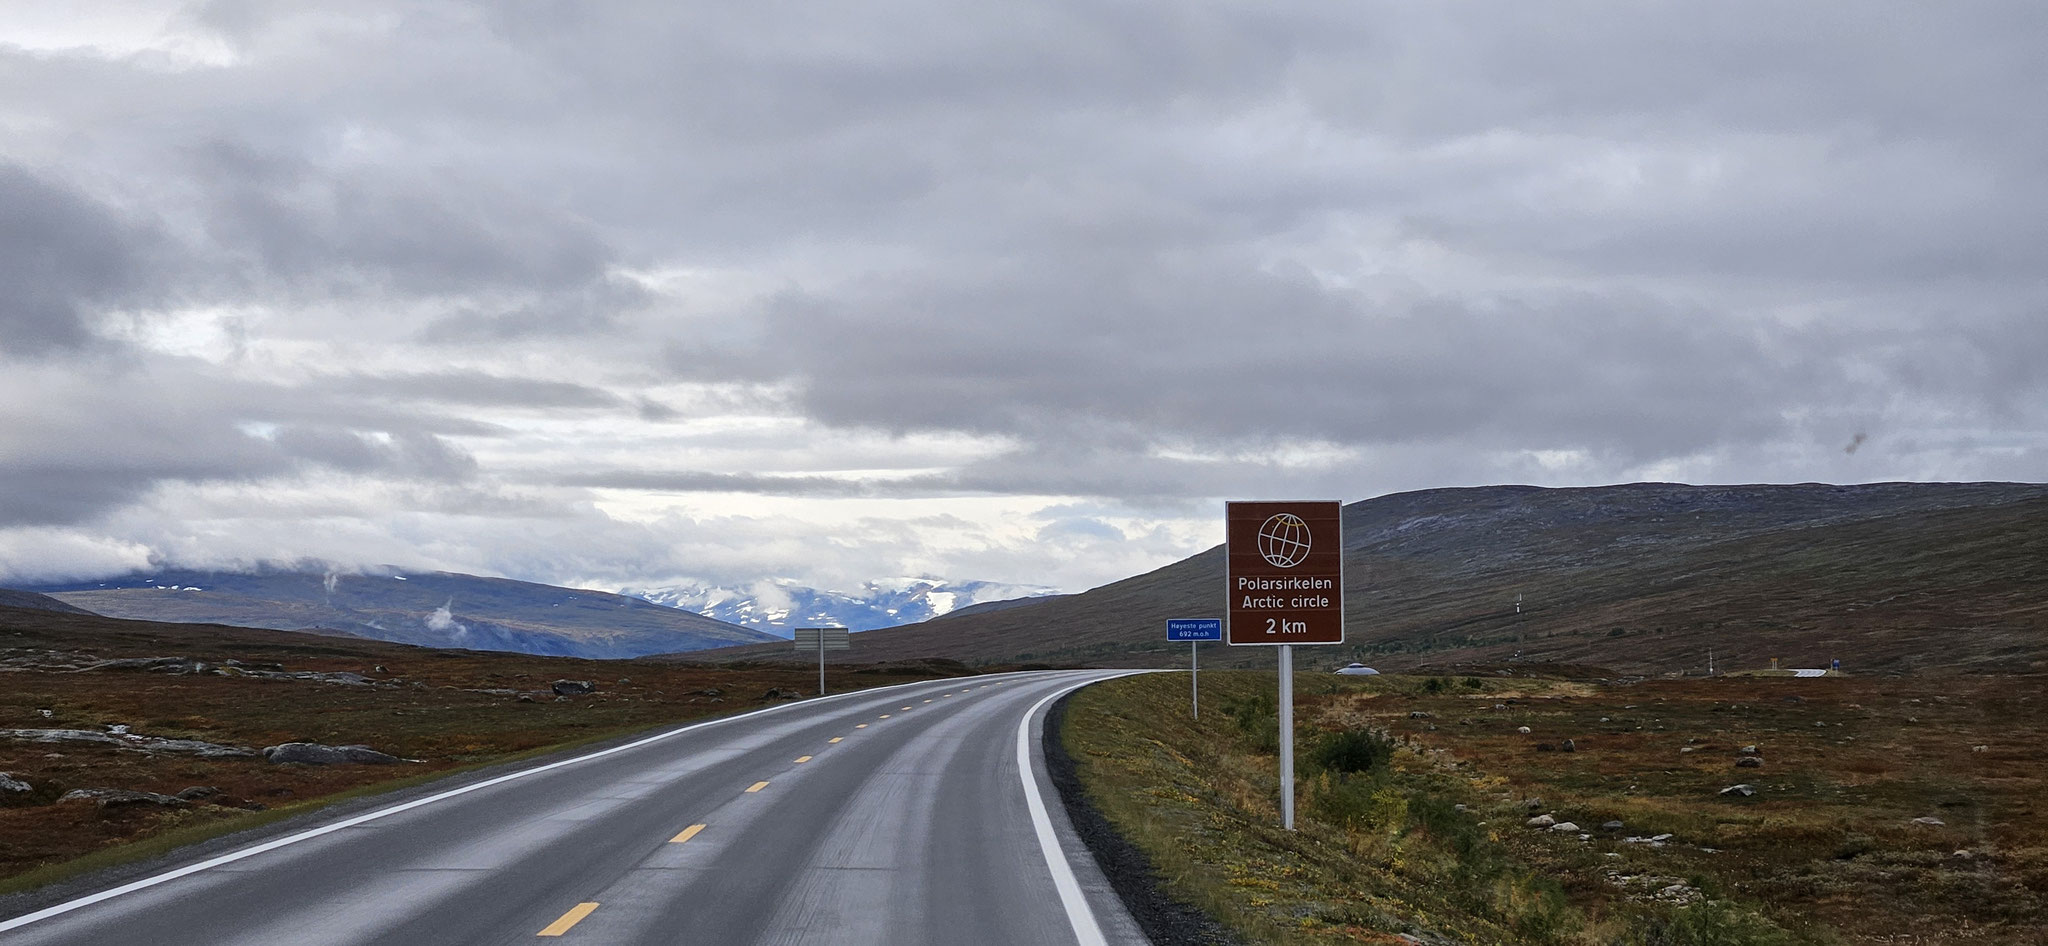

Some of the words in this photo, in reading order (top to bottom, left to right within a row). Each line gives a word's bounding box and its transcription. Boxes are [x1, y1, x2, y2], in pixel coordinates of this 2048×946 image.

[1238, 576, 1332, 590] Polarsirkelen
[1242, 595, 1284, 608] Arctic
[1291, 595, 1329, 608] circle
[1198, 622, 1217, 630] punkt
[1265, 618, 1276, 634] 2
[1282, 618, 1307, 634] km
